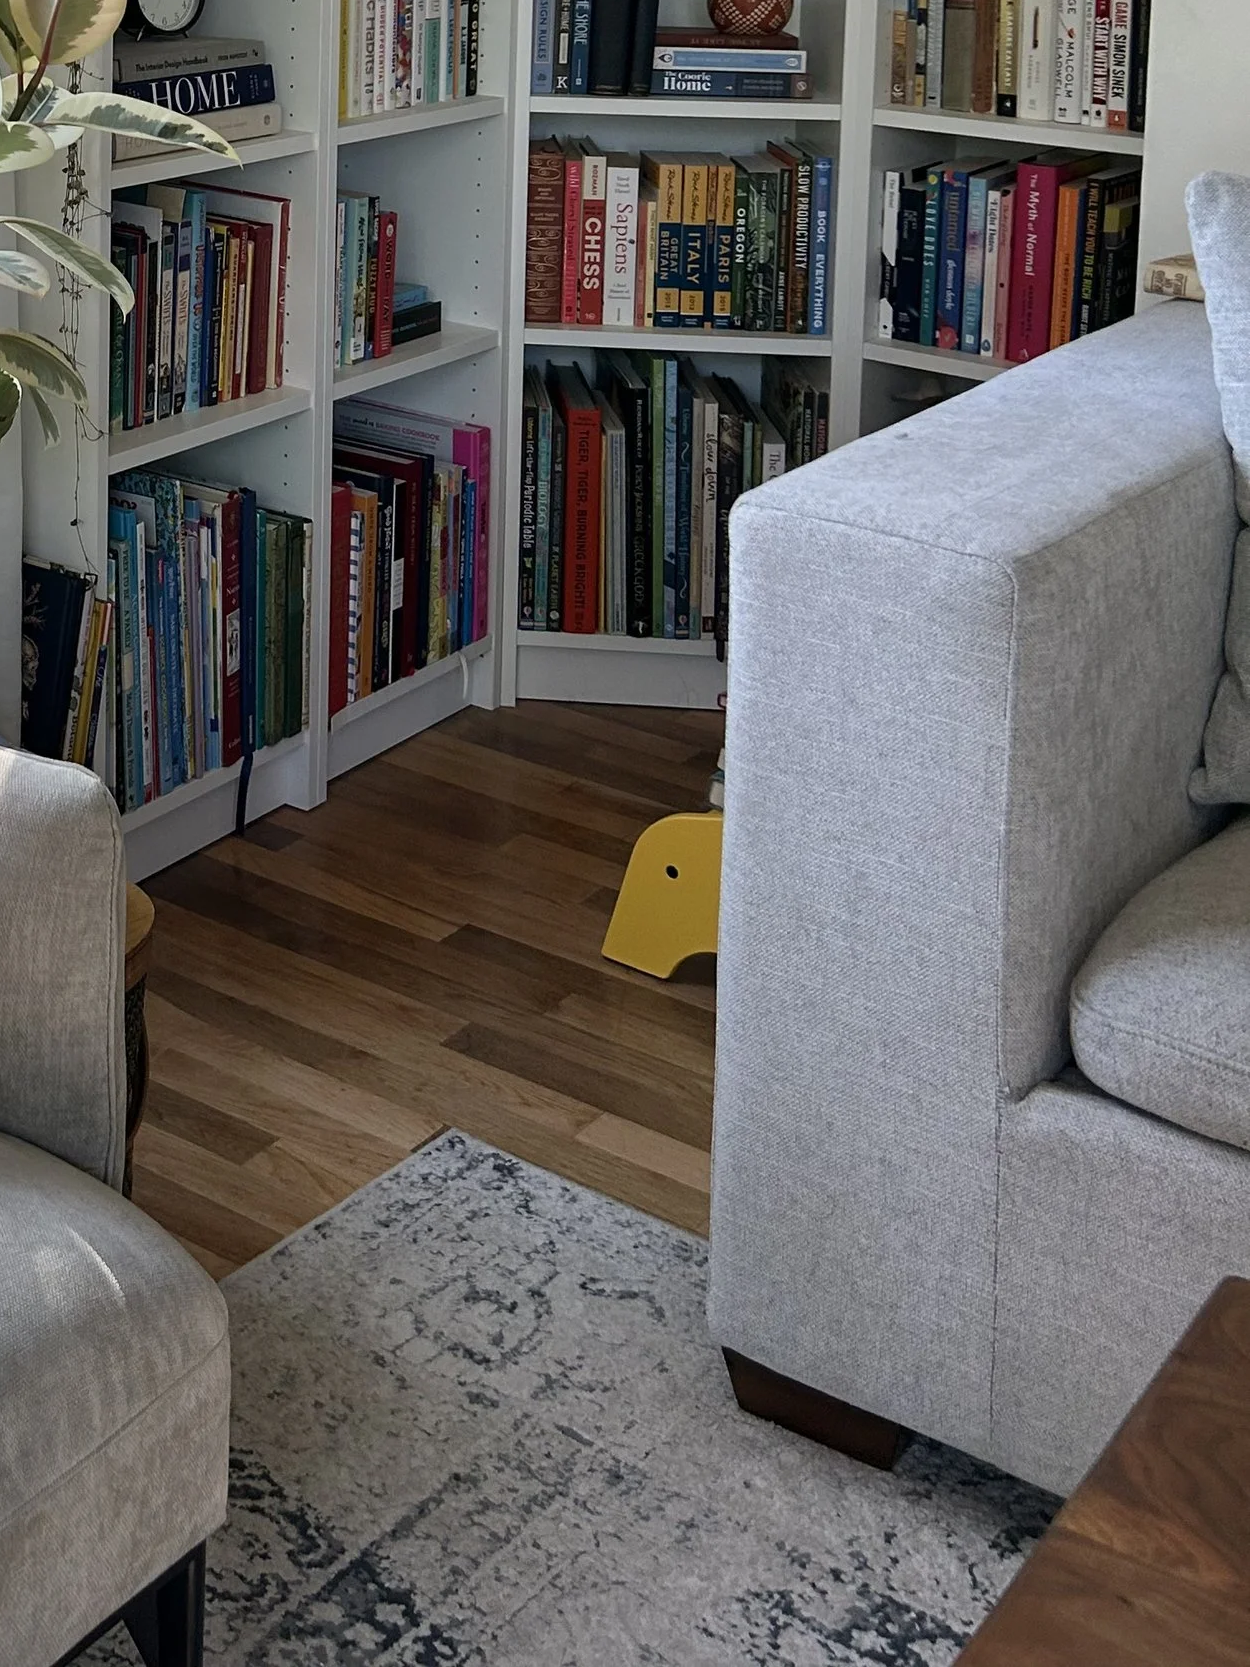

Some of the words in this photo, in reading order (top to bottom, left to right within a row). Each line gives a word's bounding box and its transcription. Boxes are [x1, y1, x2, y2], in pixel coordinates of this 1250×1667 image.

[378, 5, 386, 35] HIDDEN
[560, 10, 569, 30] HOME
[574, 12, 588, 45] SHORE
[1006, 11, 1014, 47] LEADERS
[1114, 1, 1128, 29] GAME
[365, 17, 377, 75] Habits
[469, 21, 477, 71] GREAT
[538, 28, 547, 59] RULES
[1095, 17, 1109, 48] START
[377, 37, 385, 84] POTENTIAL
[1004, 50, 1012, 66] EAT
[1094, 50, 1108, 76] WITH
[1112, 33, 1127, 67] SIMON
[1055, 38, 1064, 99] GLADWELL
[1064, 41, 1075, 99] MALCOLM
[1111, 69, 1125, 99] SINEK
[149, 71, 241, 114] HOME
[663, 77, 711, 92] Home
[1093, 77, 1107, 100] WHY
[591, 164, 599, 196] BOZMAN
[797, 165, 811, 194] SLOW
[1030, 173, 1039, 190] The
[1026, 191, 1041, 221] Myth
[1089, 188, 1098, 206] WILL
[815, 210, 827, 244] BOOK
[924, 201, 938, 231] LOVE
[944, 192, 961, 252] untamed
[987, 200, 998, 226] Eight
[1086, 209, 1097, 236] TEACH
[614, 202, 635, 274] Sapiens
[734, 207, 747, 264] OREGON
[793, 196, 810, 269] PRODUCTIVITY
[987, 228, 997, 253] Dates
[1085, 236, 1096, 254] YOU
[583, 217, 602, 290] CHESS
[659, 230, 670, 280] BRITAIN
[669, 237, 678, 273] GREAT
[686, 232, 701, 284] ITALY
[718, 234, 731, 284] PARIS
[922, 236, 937, 267] DOES
[1023, 233, 1038, 276] Normal
[1084, 254, 1095, 265] TO
[370, 258, 378, 287] FUZZY
[778, 271, 786, 287] ANNE
[1083, 266, 1093, 278] BE
[369, 291, 377, 314] MUD
[776, 288, 784, 311] LAMOTT
[812, 253, 824, 328] EVERYTHING
[1081, 278, 1092, 299] RICH
[524, 440, 534, 485] Lift-the-flap
[576, 429, 590, 465] TIGER,
[705, 434, 717, 462] slow
[768, 451, 781, 472] The
[575, 469, 589, 506] TIGER,
[704, 467, 717, 502] down
[522, 485, 535, 524] Periodic
[537, 481, 548, 531] BIOLOGY
[523, 525, 534, 549] Table
[574, 510, 588, 561] BURNING
[123, 549, 132, 573] FREE
[123, 575, 132, 588] TO
[123, 589, 132, 601] BE
[573, 563, 587, 610] BRIGHT!
[123, 617, 133, 650] FAMILY
